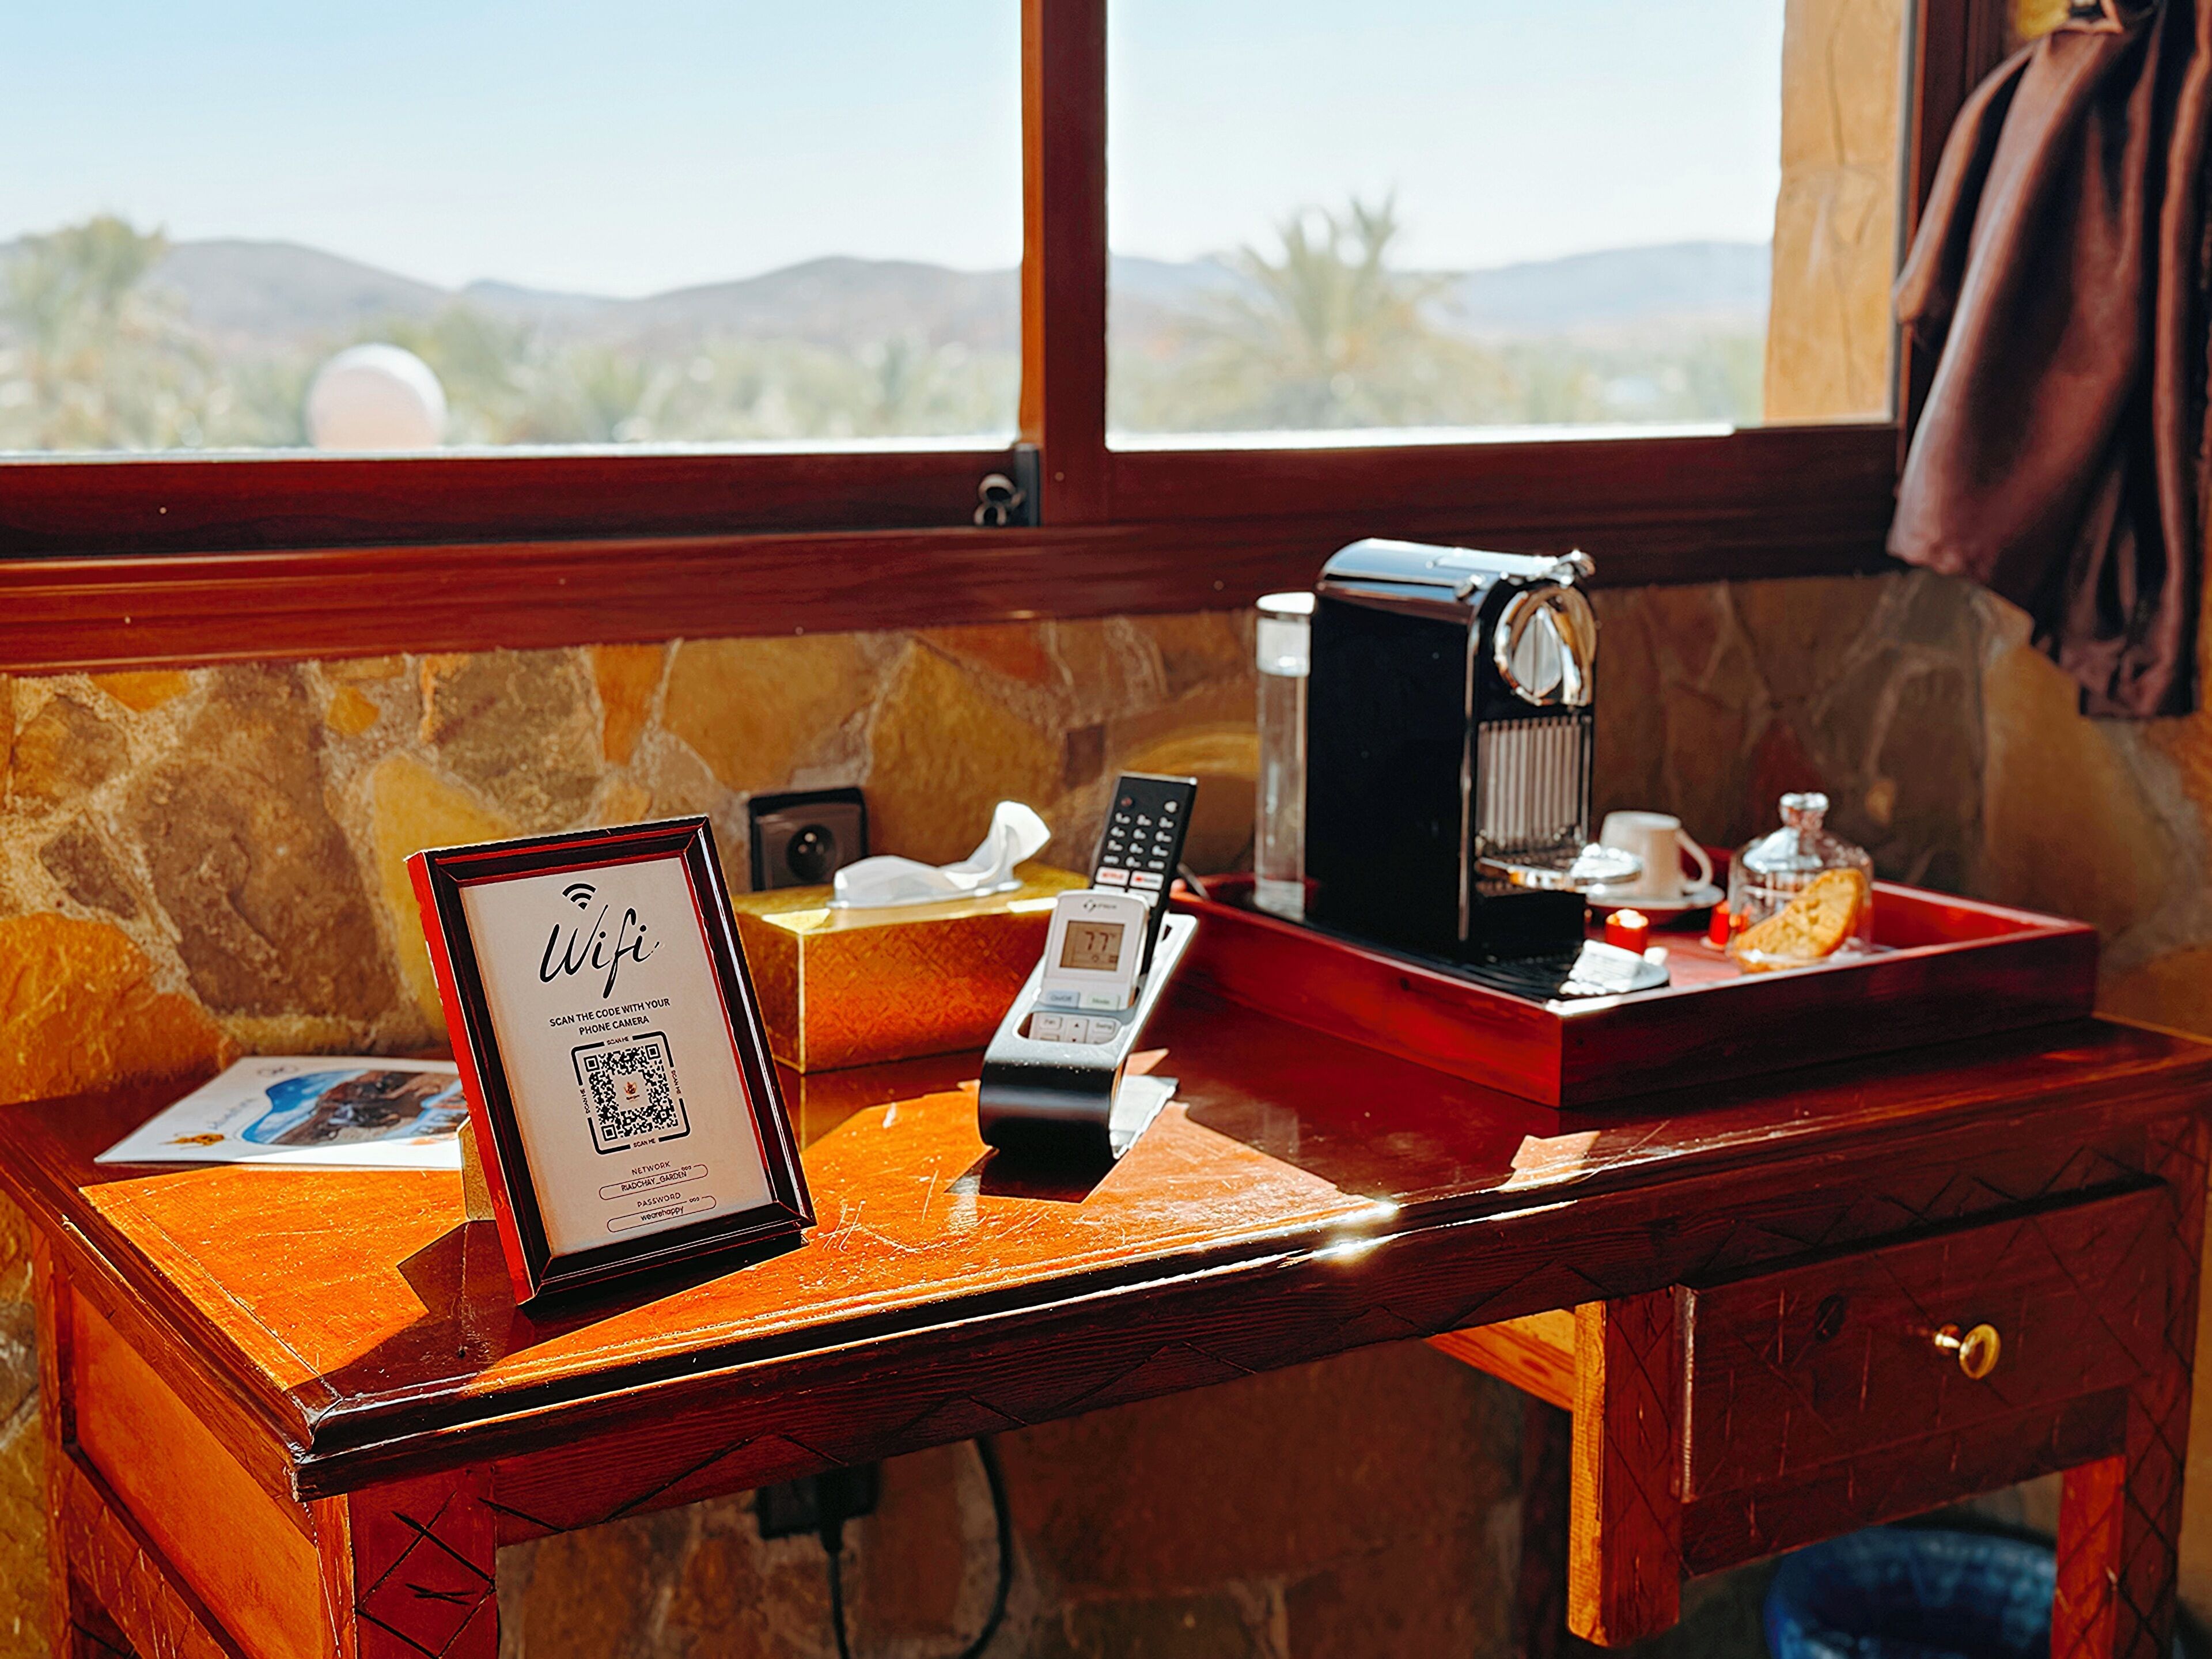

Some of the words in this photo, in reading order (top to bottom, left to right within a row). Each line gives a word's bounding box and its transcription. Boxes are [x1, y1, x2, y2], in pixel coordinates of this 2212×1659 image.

[540, 904, 660, 998] Wifi
[550, 1015, 575, 1027] SCAN
[576, 1012, 594, 1022] THE
[596, 1007, 621, 1018] CODE
[622, 1002, 644, 1014] WITH
[645, 998, 670, 1009] YOUR
[579, 1022, 611, 1035] PHONE
[612, 1016, 649, 1029] CAMERA
[632, 1161, 671, 1175] NETWORK
[621, 1171, 687, 1191] RIADCHAY_GARDEN
[637, 1192, 680, 1207] PASSWORD
[641, 1206, 684, 1221] wearehappy
